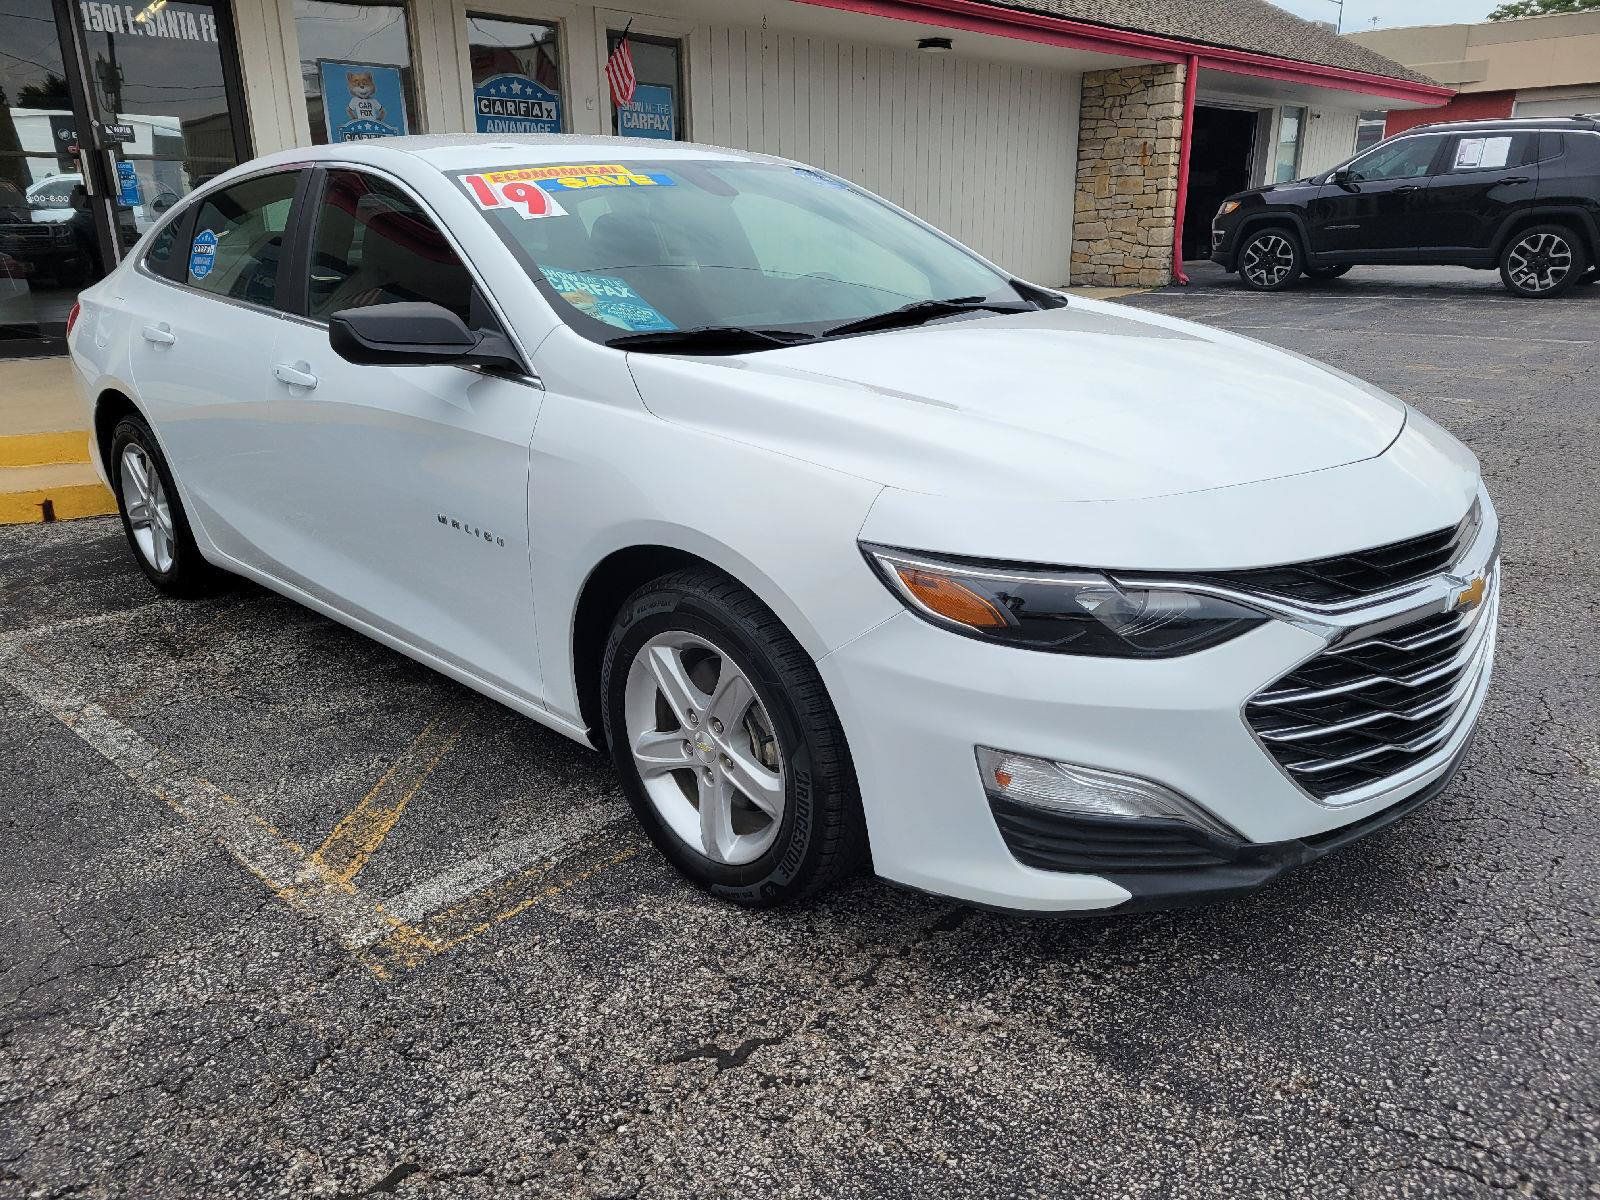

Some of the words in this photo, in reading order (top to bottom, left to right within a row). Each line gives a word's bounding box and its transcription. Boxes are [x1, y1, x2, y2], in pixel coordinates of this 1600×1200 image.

[80, 1, 125, 33] 1501
[125, 5, 143, 36] E.
[144, 8, 199, 40] SANTA
[200, 13, 218, 41] FE
[480, 100, 553, 119] CARFAX
[621, 101, 644, 113] SHOW
[657, 103, 669, 115] THE
[487, 120, 551, 133] ADVANTAGE
[623, 112, 669, 131] CARFAX
[491, 166, 625, 183] ECONOMICAL
[557, 175, 658, 189] SAVE
[547, 277, 637, 299] CARFAX
[437, 513, 504, 547] MALIBU
[778, 770, 811, 880] BRIDGESTONE
